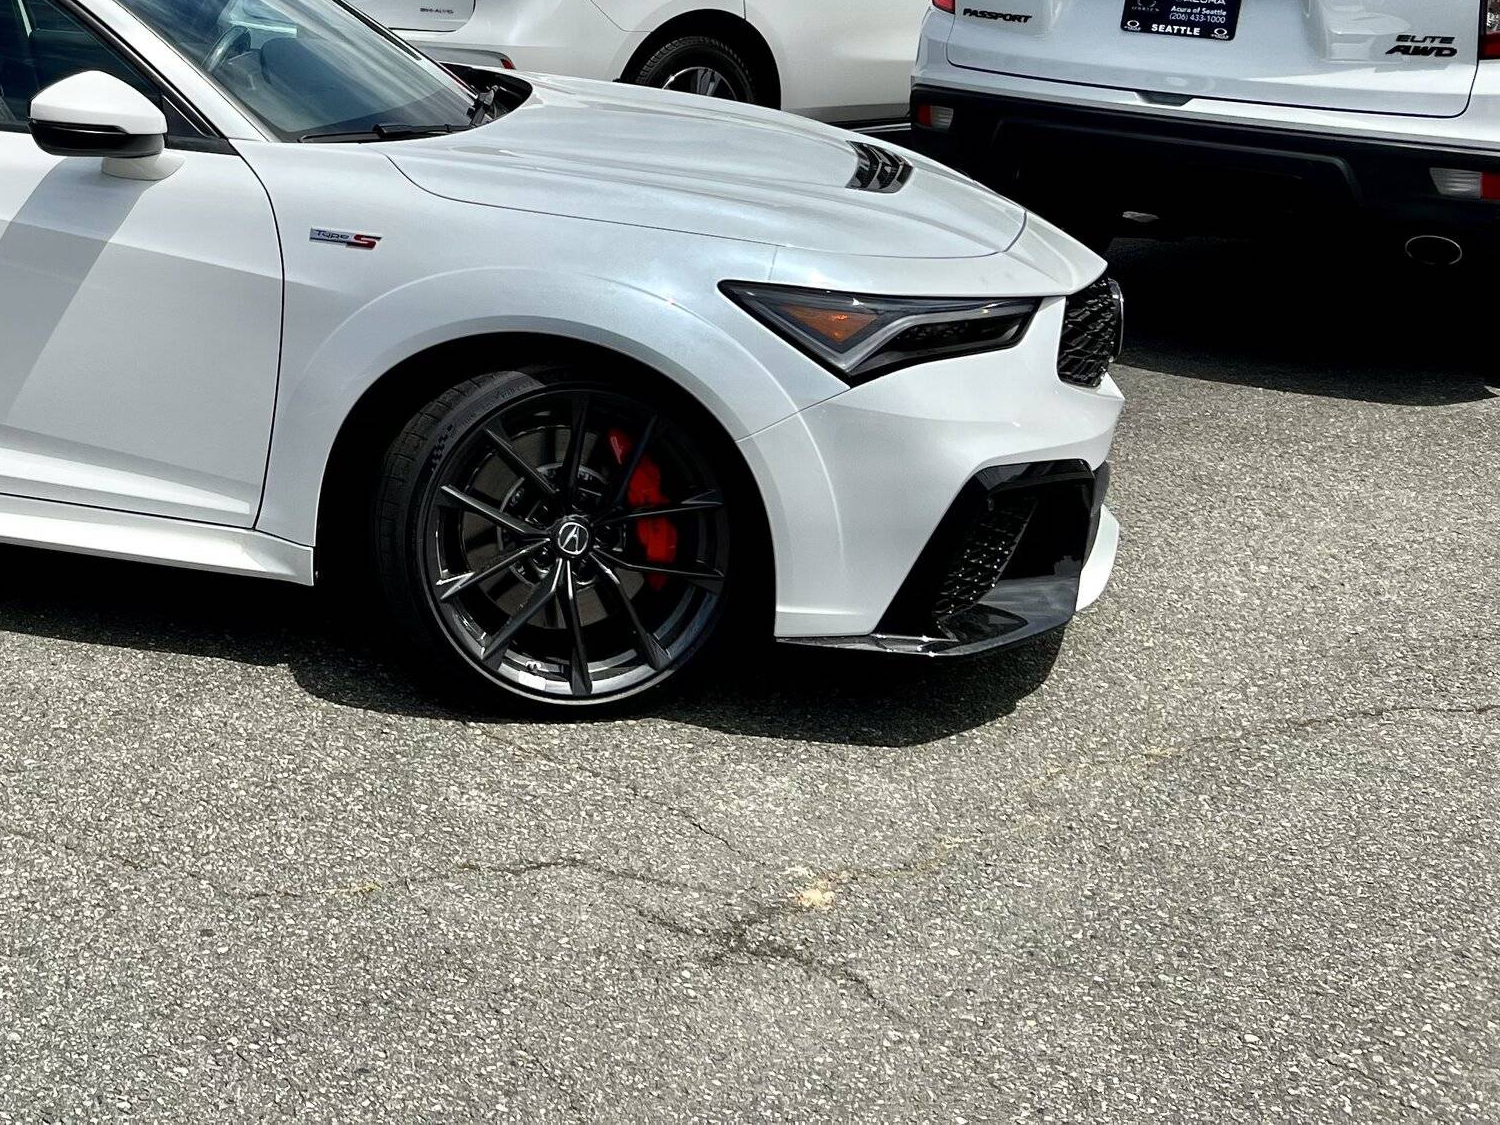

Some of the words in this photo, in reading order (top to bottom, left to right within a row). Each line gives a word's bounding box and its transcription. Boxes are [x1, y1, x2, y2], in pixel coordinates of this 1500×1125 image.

[962, 8, 1033, 23] PASSPORT
[1170, 5, 1191, 13] Acura
[1201, 7, 1227, 16] Seattle
[1169, 13, 1189, 22] (206)
[1190, 14, 1226, 24] 433-1000
[1151, 23, 1201, 36] SEATTLE
[1396, 34, 1455, 44] ELITE
[1385, 44, 1458, 57] AWD
